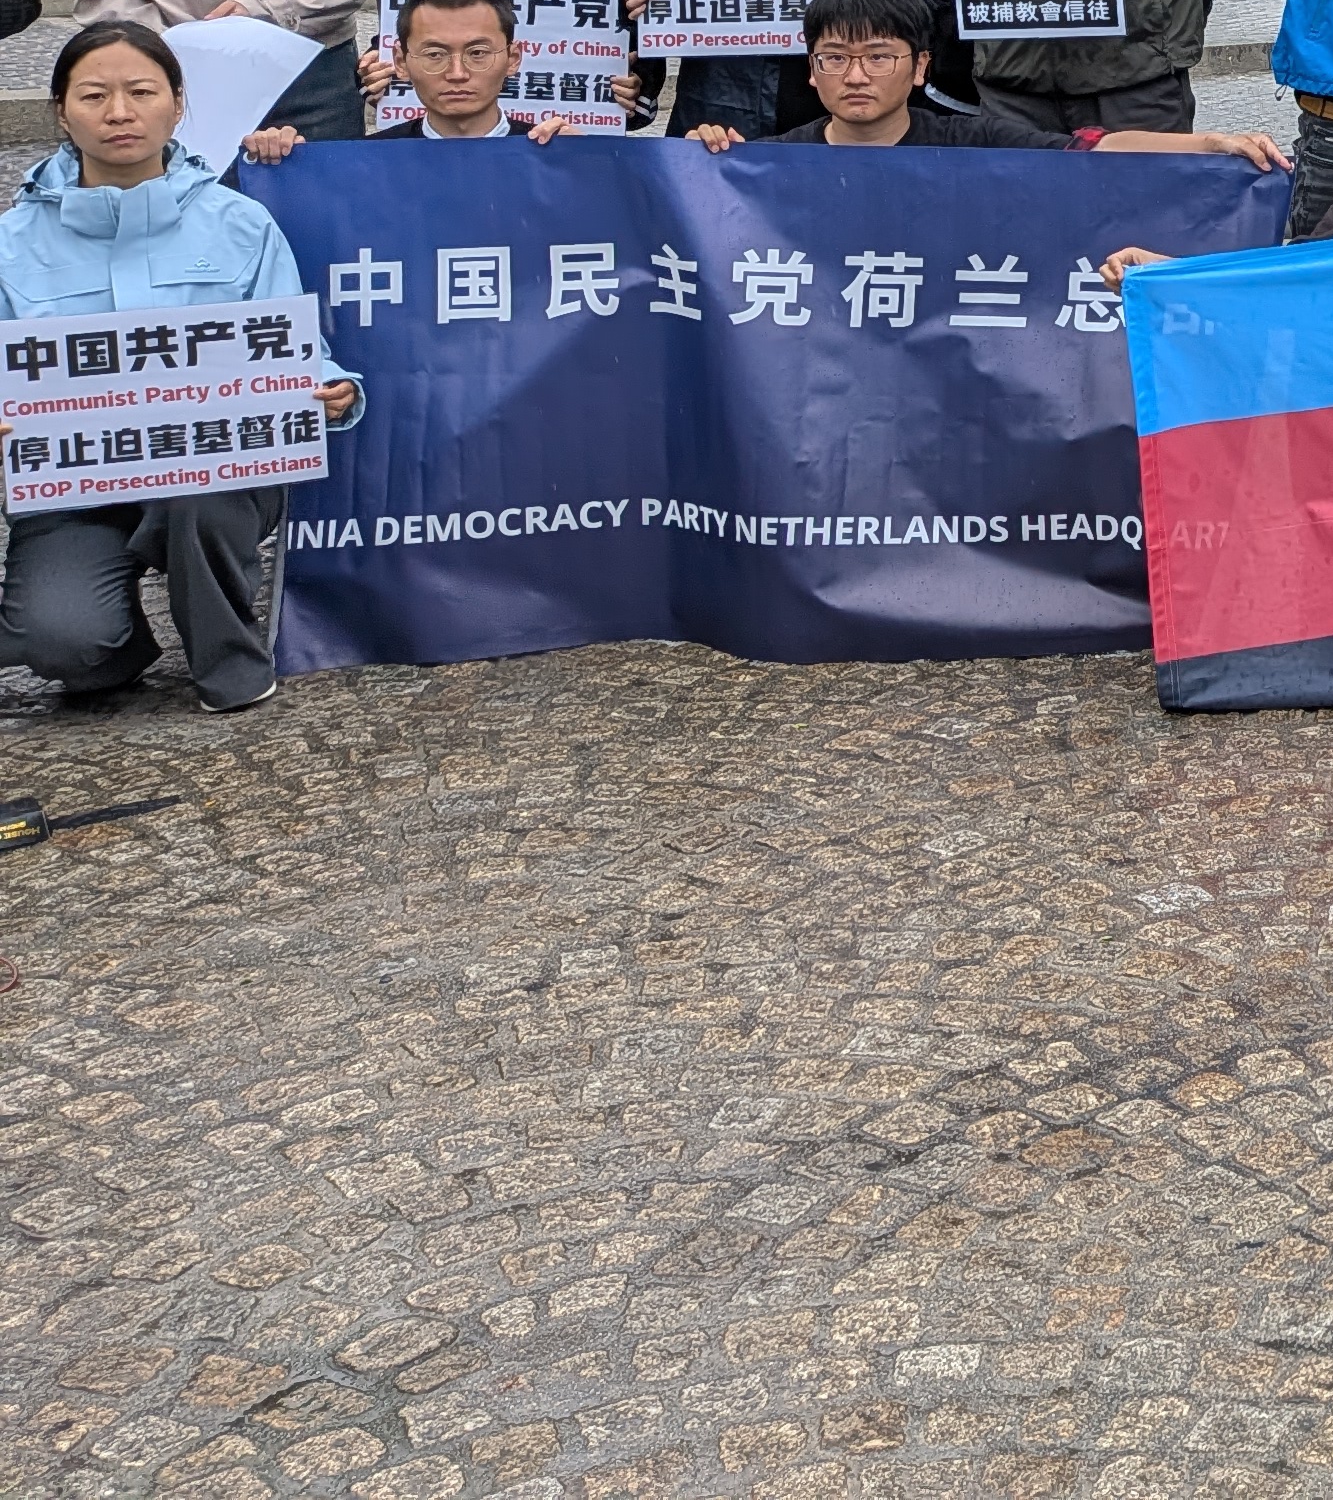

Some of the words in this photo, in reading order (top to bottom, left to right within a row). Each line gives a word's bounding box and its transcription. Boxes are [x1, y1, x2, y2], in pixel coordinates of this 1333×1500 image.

[966, 0, 1111, 24] 被捕教會信徒
[548, 40, 568, 55] of
[573, 40, 627, 60] China,
[642, 33, 688, 48] STOP
[692, 31, 792, 49] Persecuting
[329, 242, 1125, 333] 中国民主党荷兰总
[3, 389, 139, 418] Communist
[145, 383, 211, 404] Party
[218, 378, 243, 397] of
[250, 373, 320, 394] China,
[7, 409, 322, 475] 停止迫害基督徒
[12, 480, 73, 502] STOP
[79, 468, 211, 495] Persecuting
[217, 454, 323, 480] Christians
[374, 498, 630, 548] DEMOCRACY
[641, 497, 729, 538] PARTY
[735, 514, 1009, 547] NETHERLANDS
